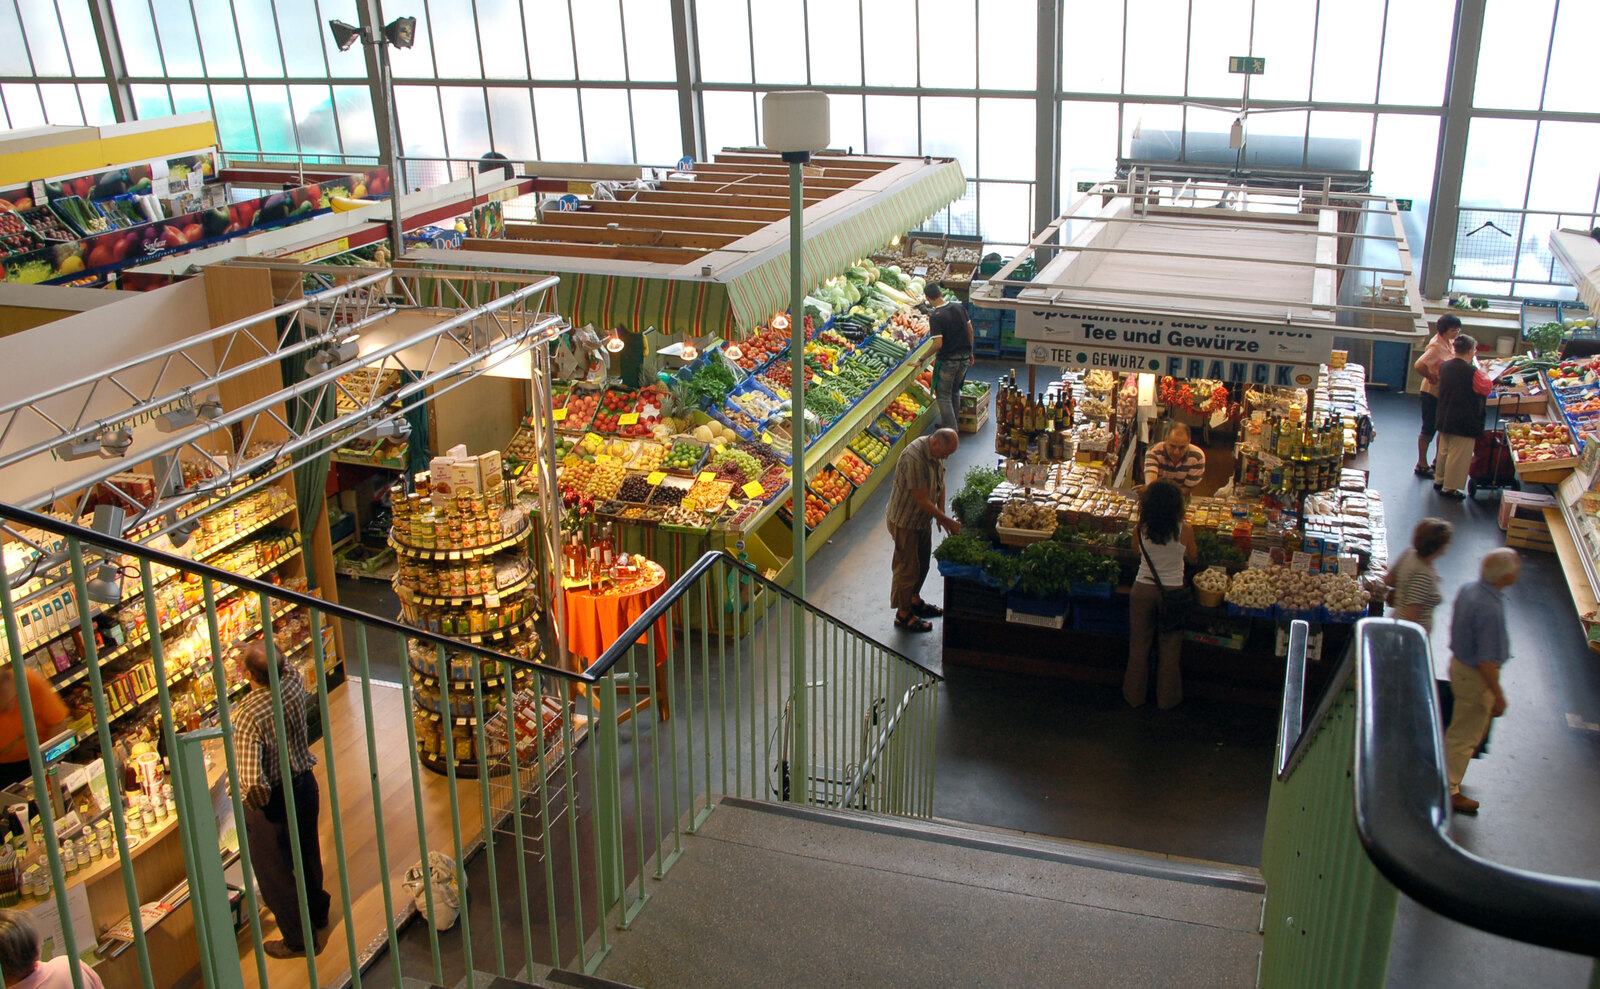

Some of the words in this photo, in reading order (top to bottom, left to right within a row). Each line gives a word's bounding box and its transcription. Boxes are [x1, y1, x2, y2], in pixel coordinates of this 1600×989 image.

[559, 198, 578, 212] Dodi
[434, 232, 461, 250] Dodi
[1081, 323, 1117, 341] Tee
[1123, 329, 1161, 344] und
[1167, 330, 1260, 353] Gewürze
[1050, 348, 1072, 363] TEE
[1165, 355, 1294, 387] FRANCK
